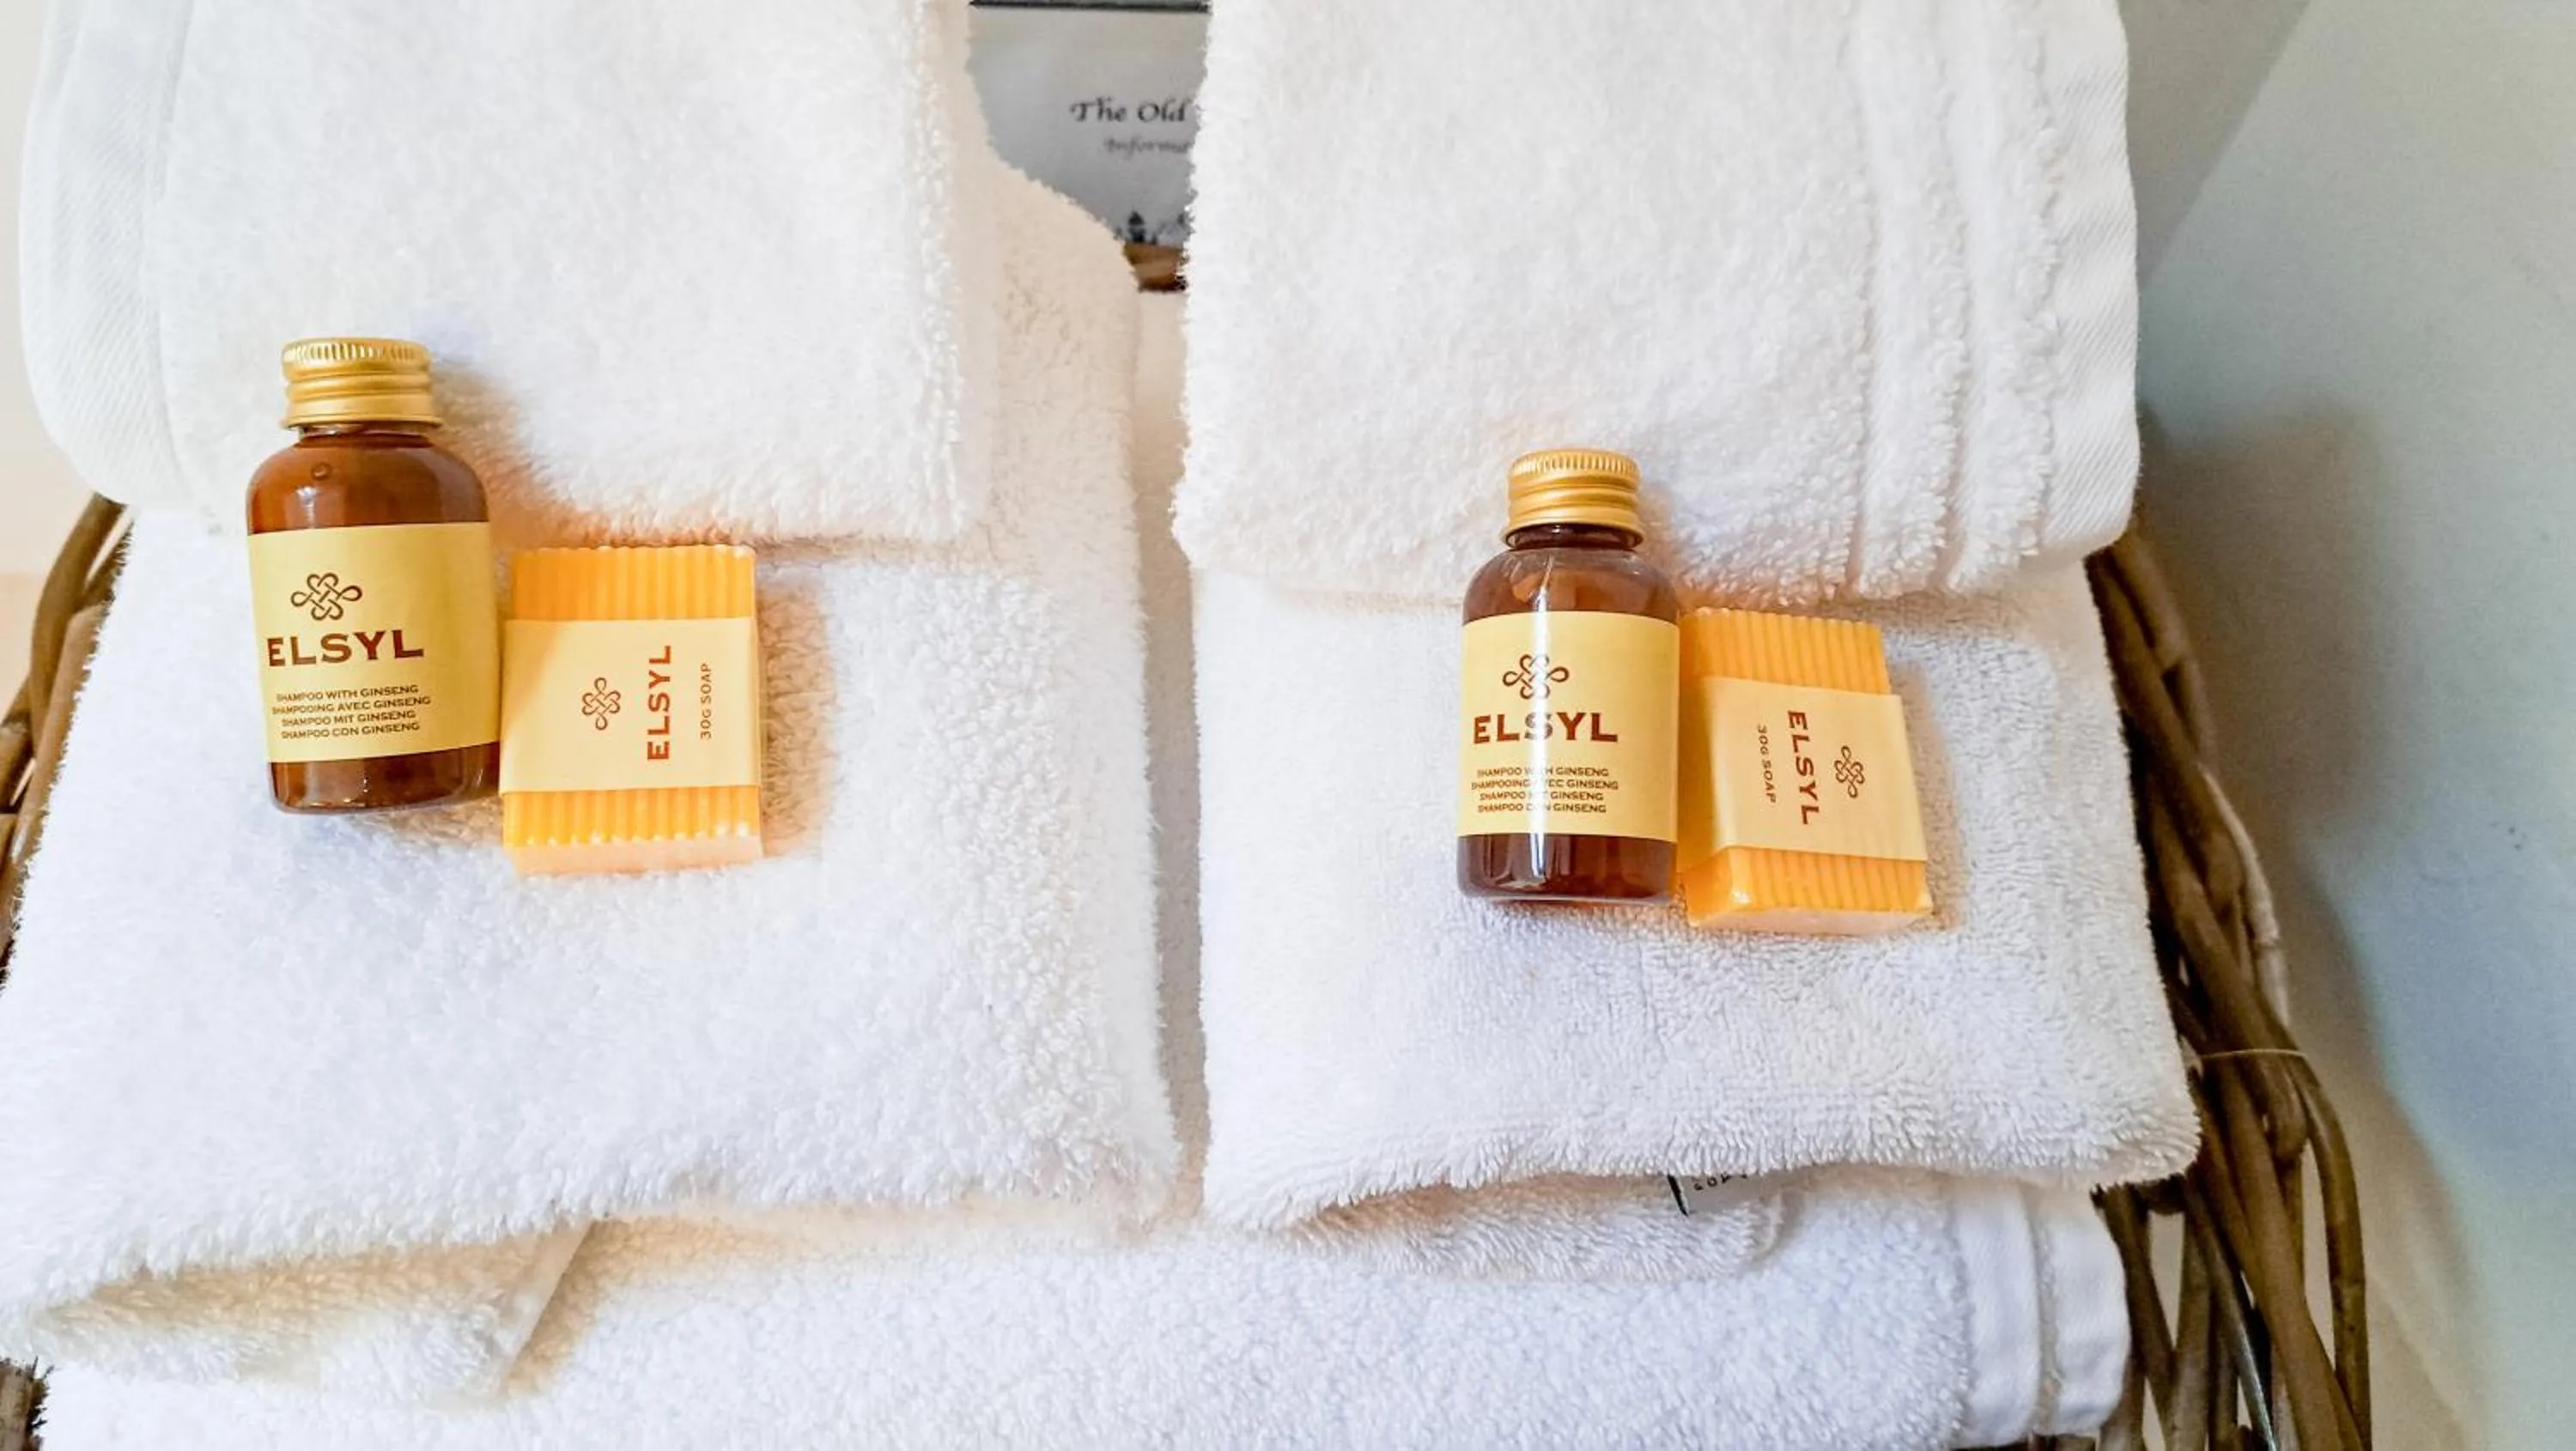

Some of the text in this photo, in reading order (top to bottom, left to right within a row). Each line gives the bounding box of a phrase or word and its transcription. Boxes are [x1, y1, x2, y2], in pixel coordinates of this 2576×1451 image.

[1069, 96, 1192, 123] The Old
[267, 629, 424, 667] ELSYL
[276, 684, 419, 702] SHAMPOO WITH GINSENG
[700, 663, 713, 739] 30G SOAP
[272, 695, 431, 715] SHAMPOOING AVEC GINSENG
[647, 645, 671, 762] ELSYL
[282, 710, 416, 727] SHAMPOO MIT GINSENG
[1473, 712, 1618, 744] ELSYL
[281, 722, 420, 739] SHAMPOO CON GINSENG
[1477, 767, 1522, 778] SHAMPOO
[1555, 767, 1609, 777] GINSENG
[1758, 725, 1777, 804] 30G SOAP
[1788, 710, 1820, 824] ELSYL
[1471, 779, 1530, 790] SHAMPOOING
[1566, 779, 1619, 790] GINSENG
[1479, 791, 1526, 801] SHAMPOO
[1550, 792, 1604, 801] GINSENG
[1478, 803, 1523, 813] SHAMPOO
[1553, 804, 1607, 813] GINSENG
